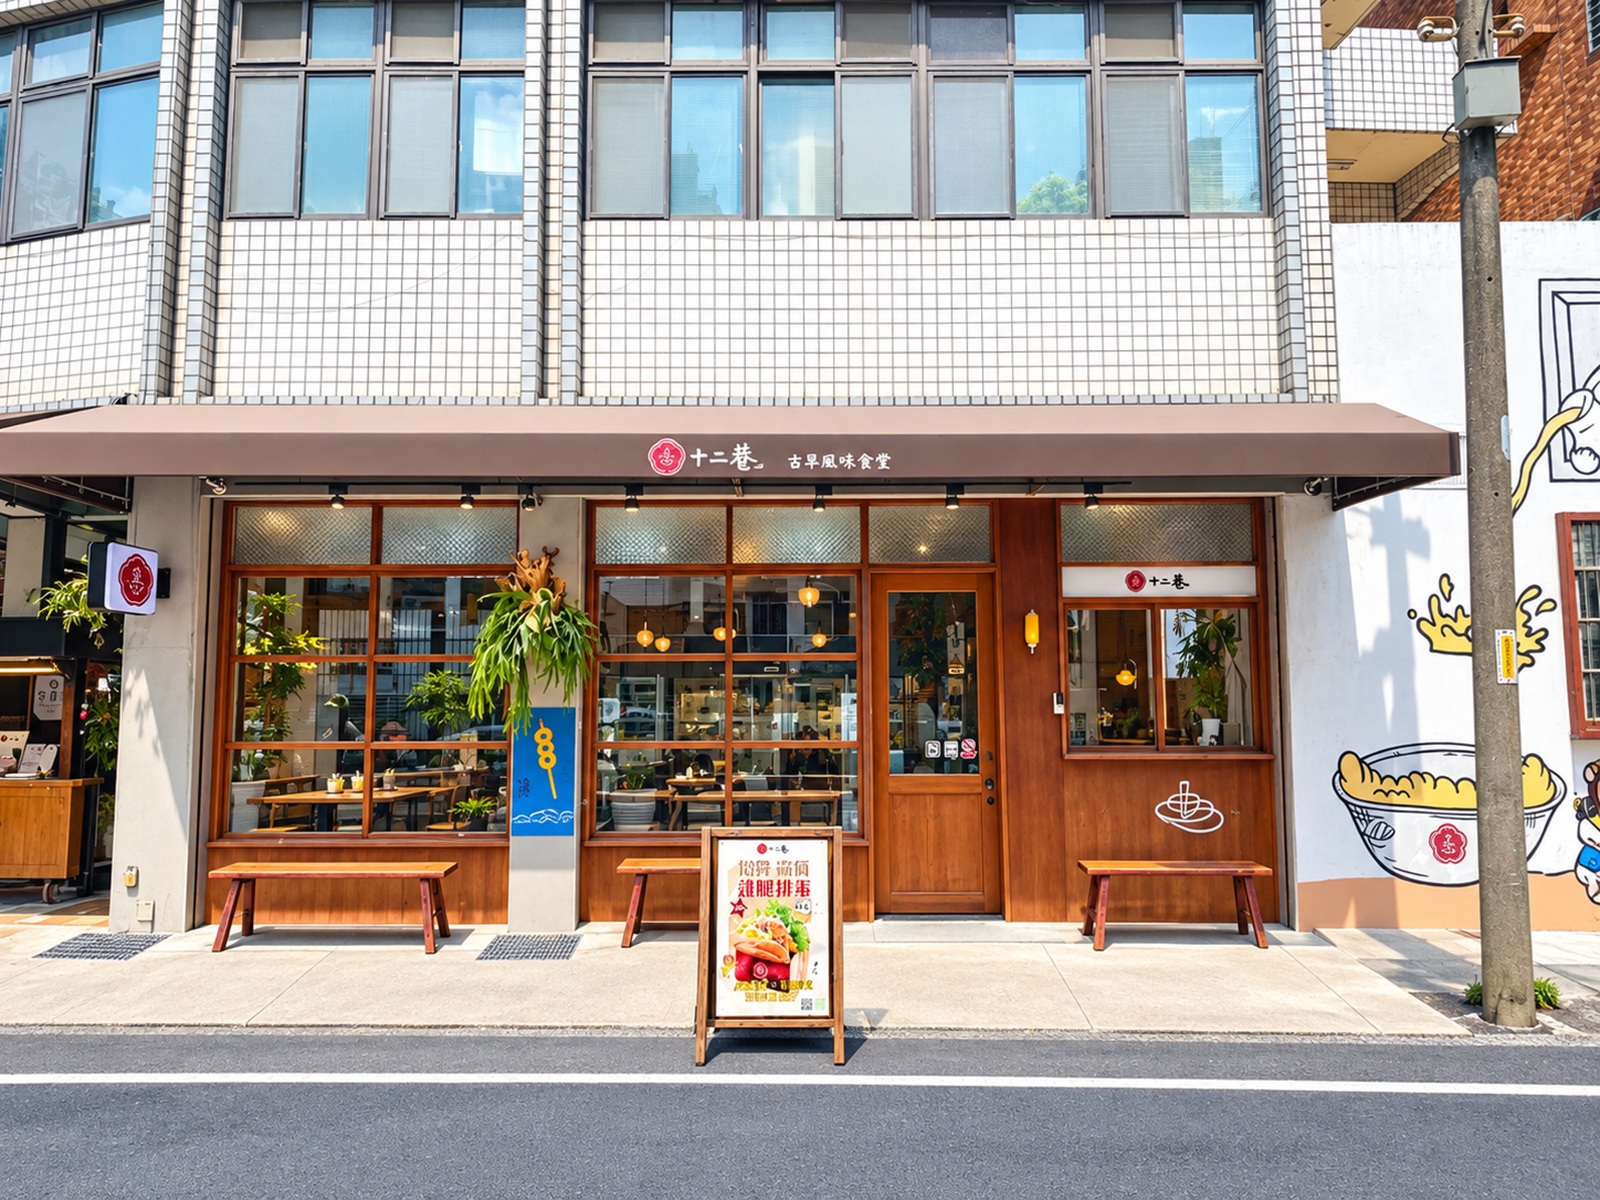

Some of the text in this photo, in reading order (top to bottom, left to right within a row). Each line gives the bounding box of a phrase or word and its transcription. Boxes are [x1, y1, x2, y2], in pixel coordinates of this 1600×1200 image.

[690, 442, 764, 471] 十二巷
[788, 453, 892, 470] 古早風味食堂
[1149, 573, 1190, 590] 十二巷
